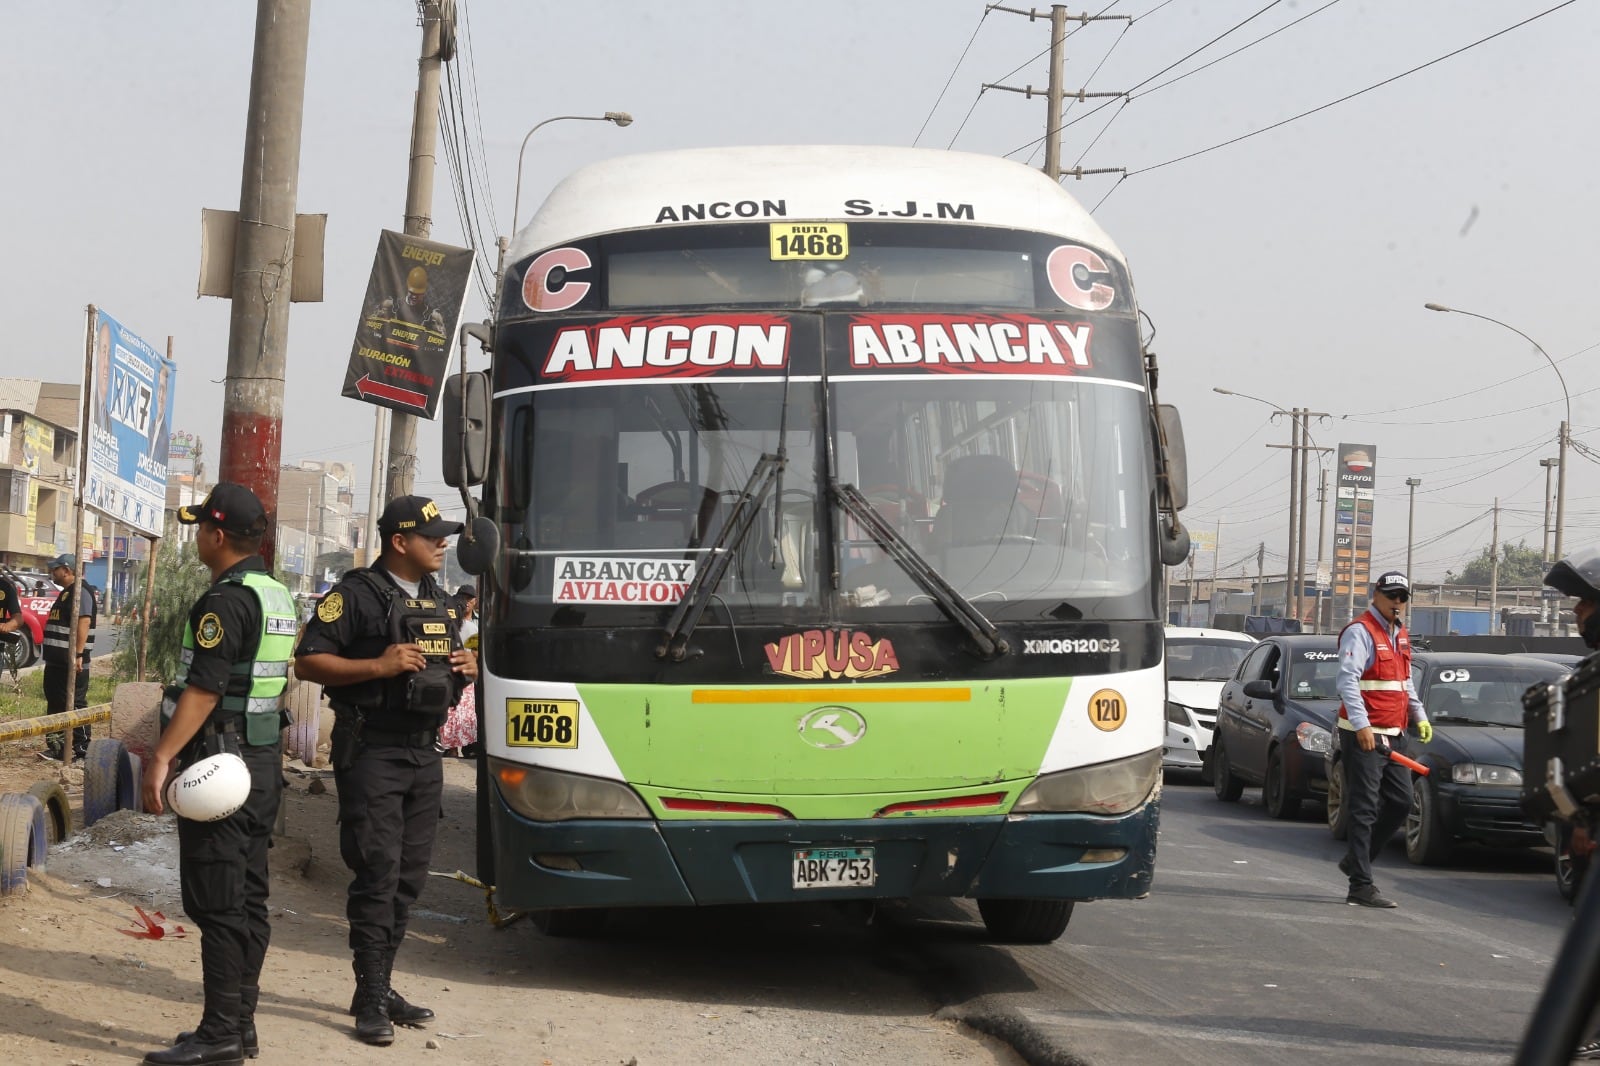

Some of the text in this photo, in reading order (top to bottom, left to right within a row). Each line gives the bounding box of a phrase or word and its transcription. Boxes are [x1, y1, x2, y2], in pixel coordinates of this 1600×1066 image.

[655, 200, 975, 223] ANCON S.J.M
[791, 226, 828, 234] RUTA
[402, 245, 446, 266] ENERJET
[776, 235, 843, 256] 1468
[522, 247, 592, 312] C
[1046, 245, 1116, 311] C
[544, 325, 788, 374] ANCON
[851, 323, 1092, 367] ABANCAY
[358, 347, 411, 369] DURACIÓN
[1342, 474, 1372, 482] REPSOL
[559, 561, 690, 582] ABANCAY
[558, 582, 689, 603] AVIACION
[417, 640, 449, 653] POLICIA
[764, 629, 900, 679] VIPUSA
[1023, 639, 1120, 654] XMQ6120C2
[1439, 668, 1470, 682] 09
[524, 703, 559, 714] RUTA
[1095, 698, 1120, 722] 120
[511, 714, 572, 743] 1468
[183, 763, 220, 789] POLICIA
[819, 850, 848, 859] PERU
[797, 859, 871, 882] ABK-753
